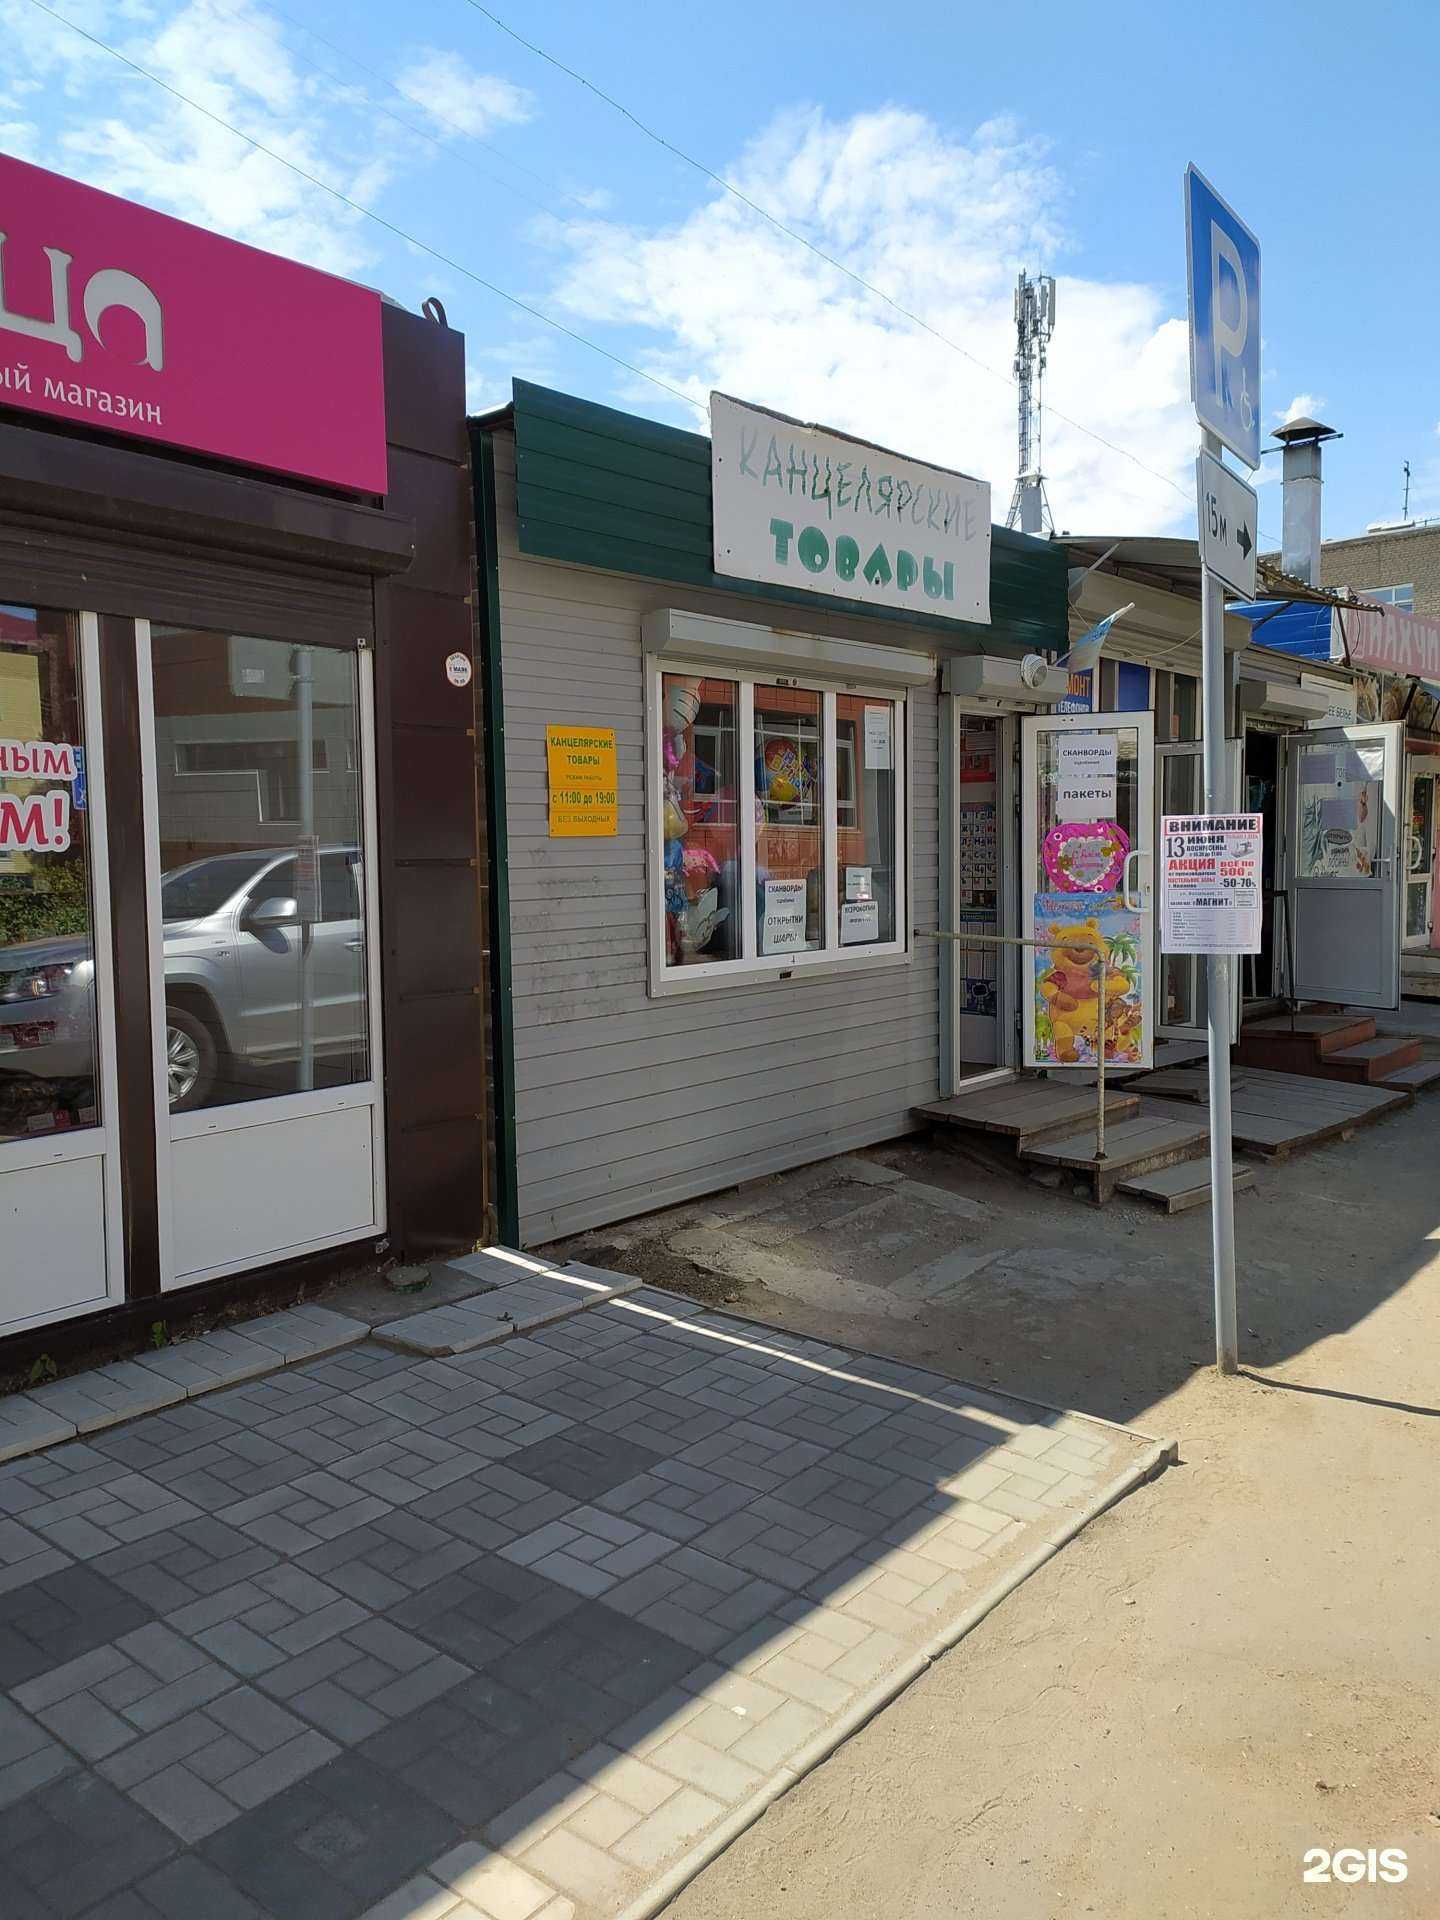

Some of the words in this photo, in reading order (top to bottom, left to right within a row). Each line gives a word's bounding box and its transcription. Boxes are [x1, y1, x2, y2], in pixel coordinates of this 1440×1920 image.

[1211, 219, 1249, 408] P
[44, 377, 162, 425] магазин
[740, 426, 977, 542] КАНЦЕЛЯРСКИЕ
[1206, 492, 1218, 538] 15
[769, 518, 954, 600] ТОВАРЫ
[550, 737, 613, 749] КАНЦЕЛЯРСКИЕ
[567, 755, 600, 765] ТОВАРЫ
[560, 791, 581, 804] 11:00
[583, 794, 592, 805] до
[596, 791, 615, 804] 19:00
[1063, 789, 1111, 799] пакеты
[573, 815, 610, 823] ВЫХОДНЫХ
[1169, 819, 1256, 832] ВНИМАНИЕ
[1166, 836, 1185, 858] 13
[1187, 835, 1225, 845] ИЮНЯ
[1186, 844, 1228, 852] ВОСКРЕСЕНЬЕ
[1168, 858, 1216, 871] АКЦИЯ
[1220, 867, 1245, 877] 500
[768, 915, 803, 926] ОТКРЫТКИ
[773, 933, 798, 944] ШАРЫ
